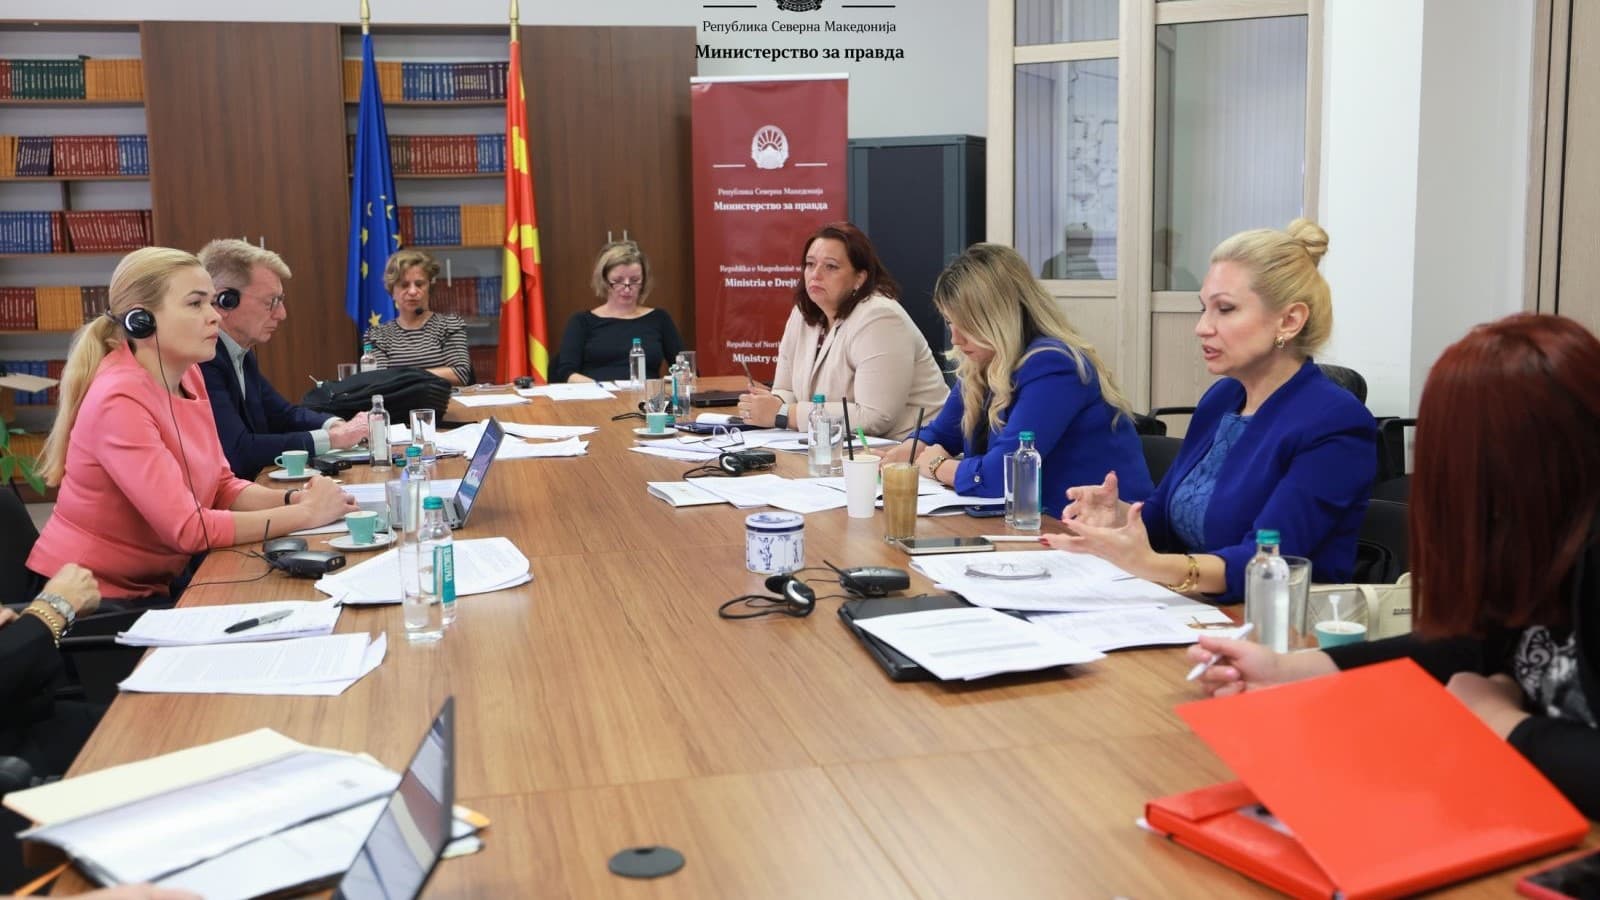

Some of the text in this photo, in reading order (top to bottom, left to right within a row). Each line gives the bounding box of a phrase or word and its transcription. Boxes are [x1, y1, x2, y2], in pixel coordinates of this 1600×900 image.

[714, 201, 781, 212] Министерство
[795, 202, 828, 212] правда
[725, 278, 766, 288] Ministria
[733, 354, 770, 364] Ministry
